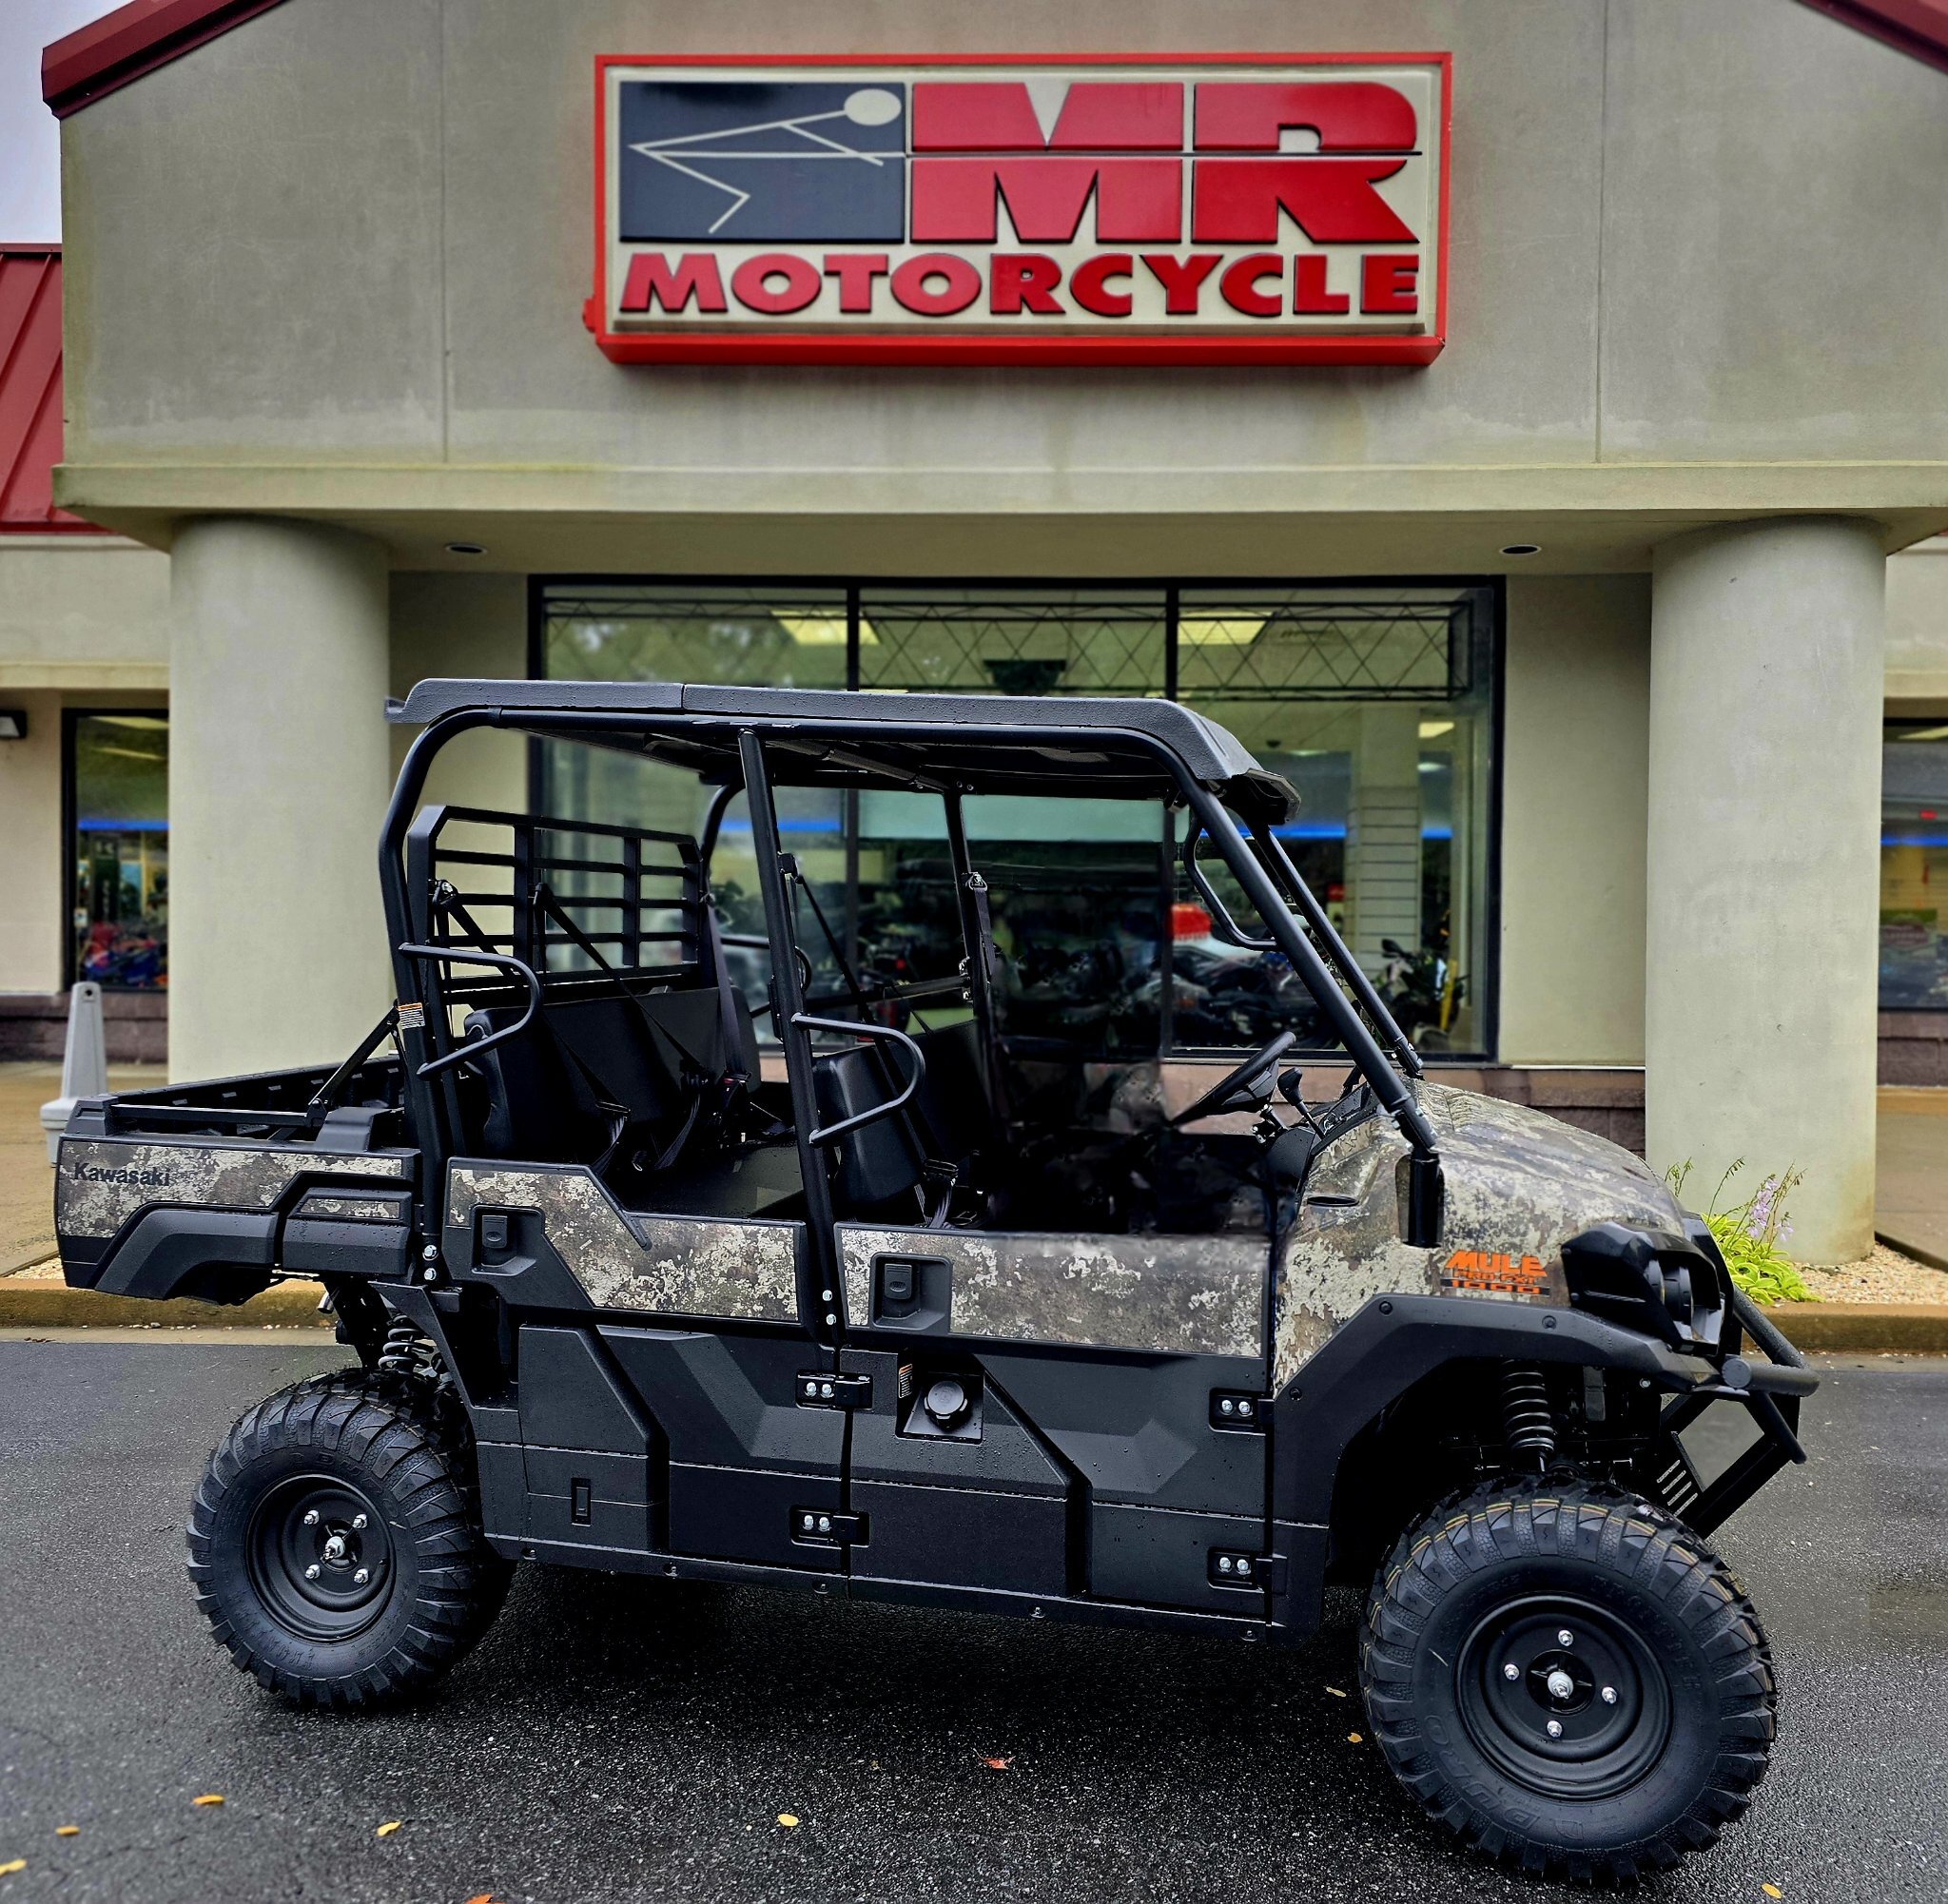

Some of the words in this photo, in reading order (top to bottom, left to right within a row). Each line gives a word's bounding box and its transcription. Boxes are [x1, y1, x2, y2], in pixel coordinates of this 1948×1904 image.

[910, 82, 1420, 244] MR
[619, 252, 1419, 317] MOTORCYCLE
[73, 1161, 170, 1187] Kawasaki
[1445, 1249, 1548, 1277] MULE
